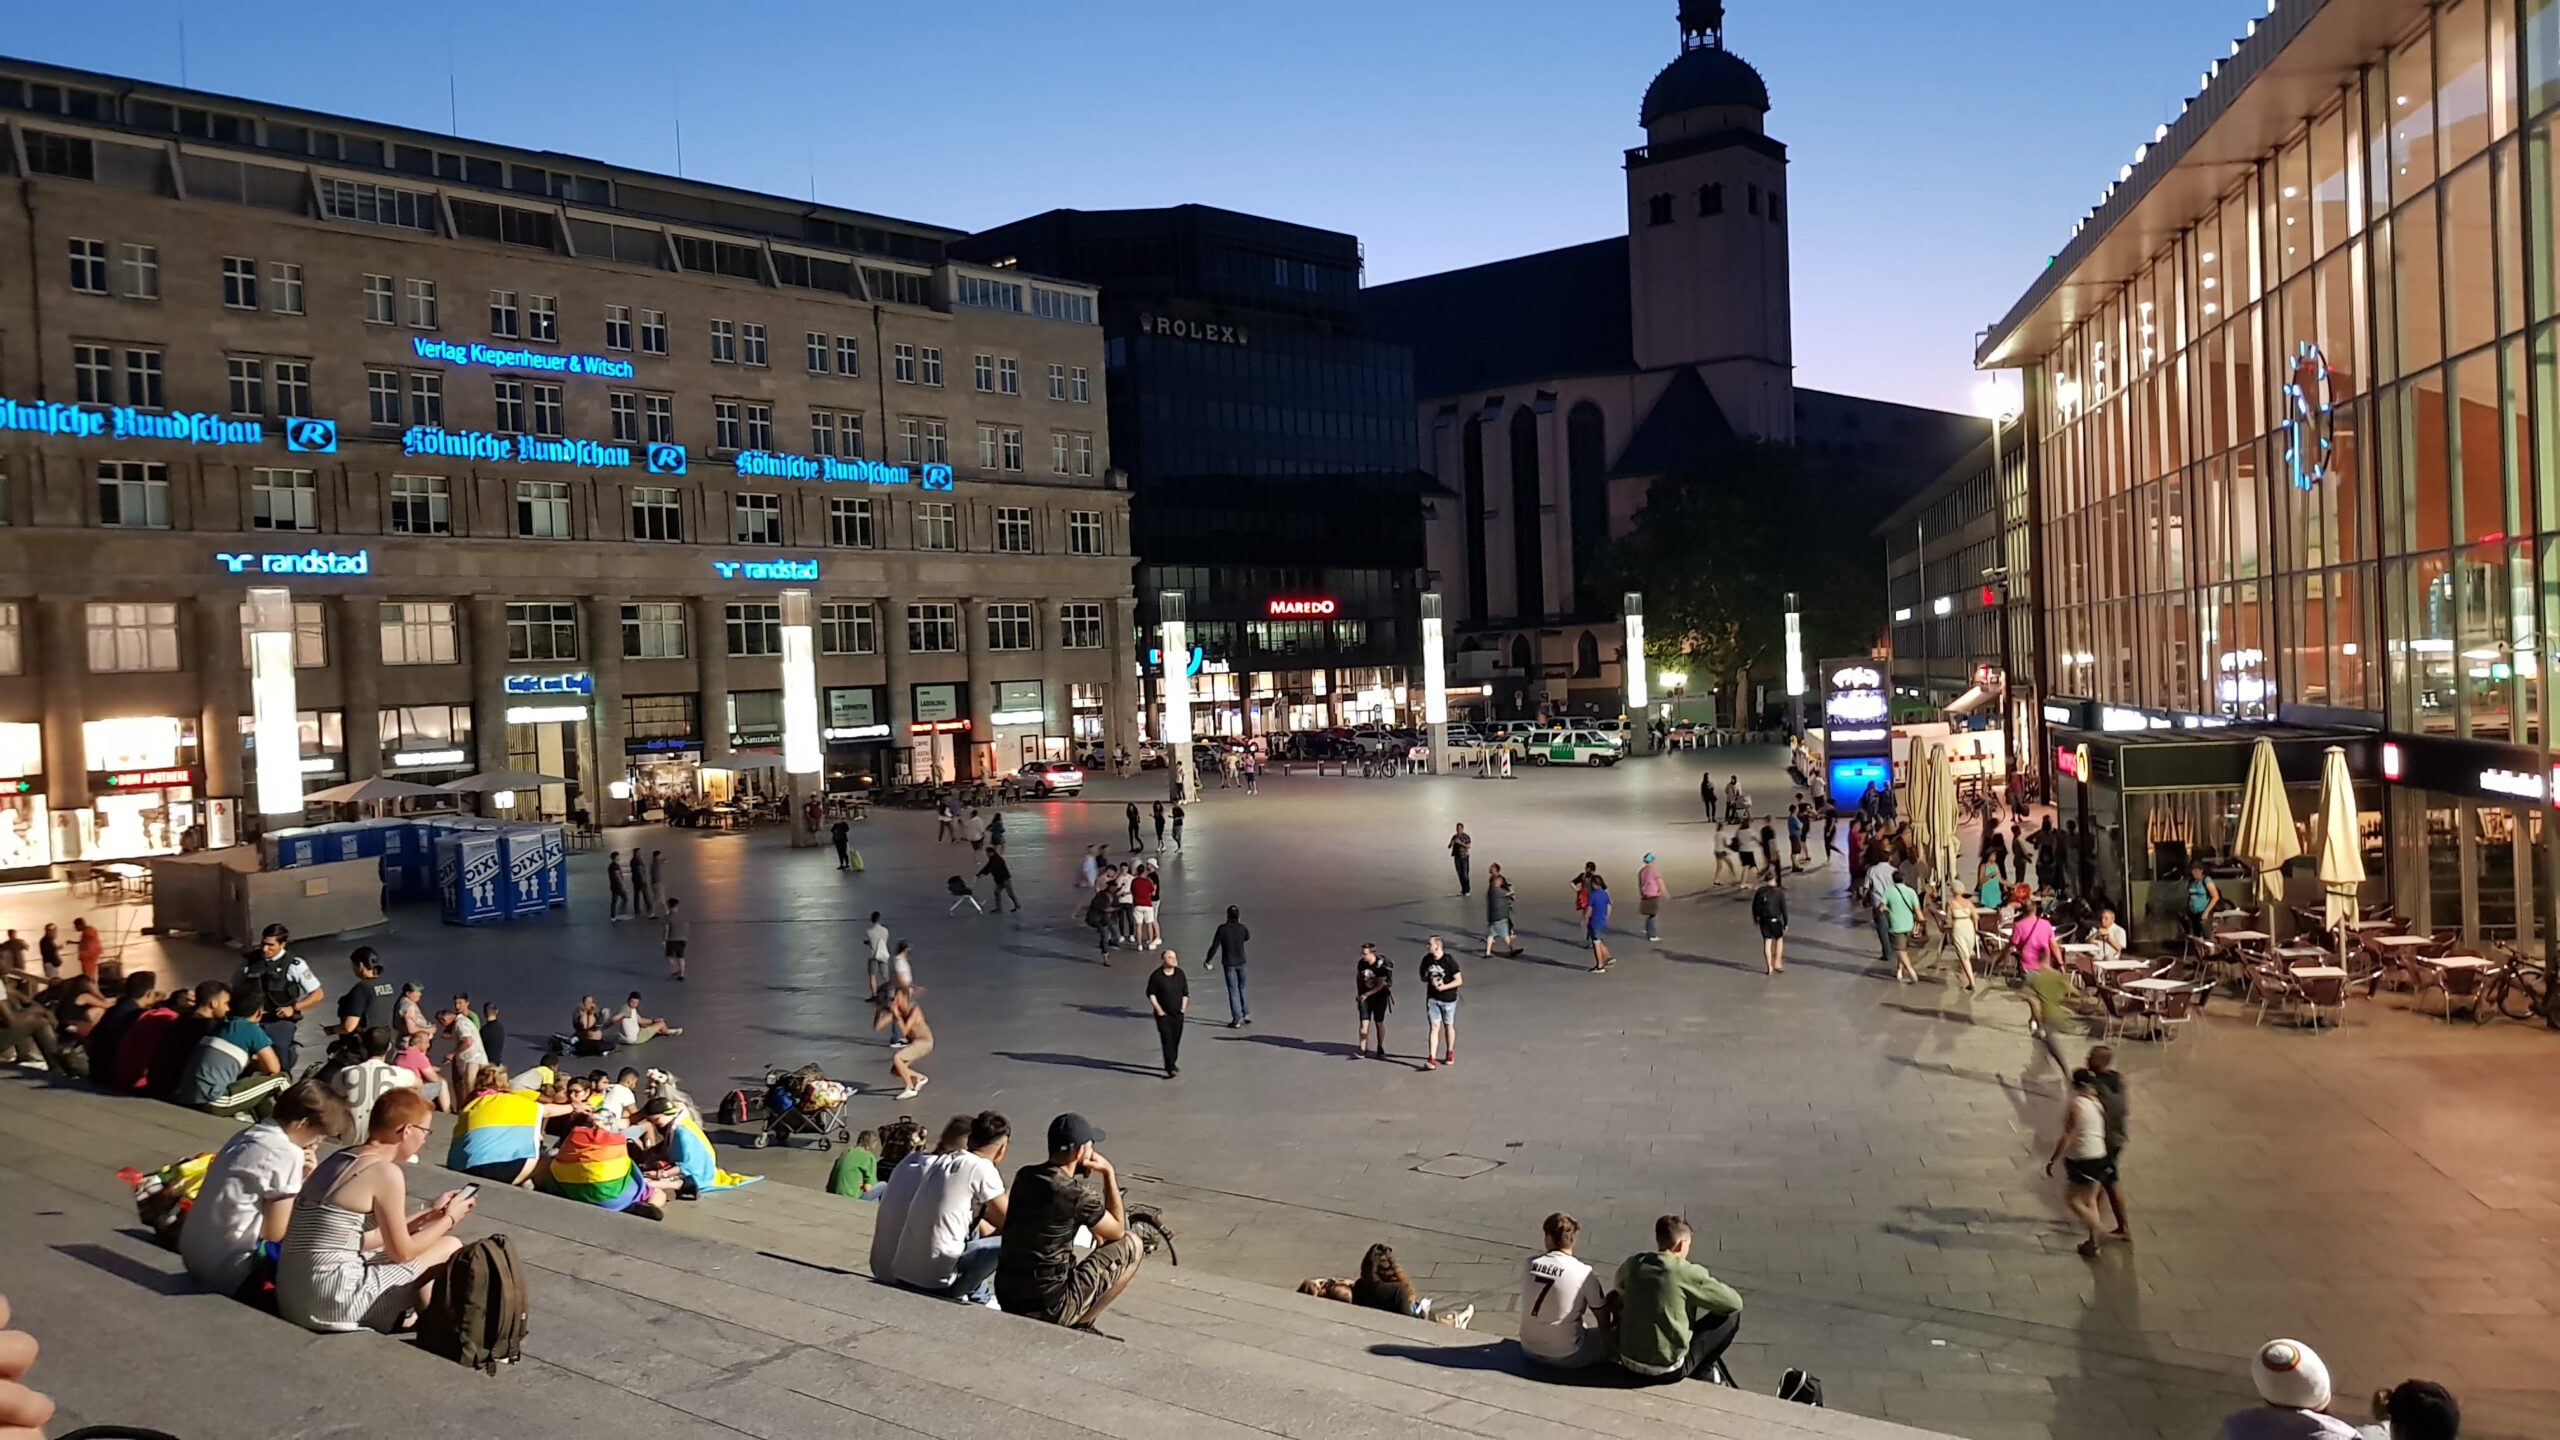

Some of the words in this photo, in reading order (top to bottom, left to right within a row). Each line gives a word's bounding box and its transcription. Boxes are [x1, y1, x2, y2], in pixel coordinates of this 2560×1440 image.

[1157, 316, 1235, 344] ROLEX
[413, 337, 467, 365] Verlag
[470, 343, 568, 371] Kiepenheuer
[569, 356, 581, 371] &
[583, 355, 634, 378] Witsch
[261, 548, 369, 574] randstad
[744, 558, 819, 581] randstad
[1270, 600, 1335, 614] MAREDO
[1201, 658, 1229, 674] Bank
[743, 730, 782, 744] Santander
[342, 1065, 397, 1108] 96
[1531, 1275, 1555, 1317] 7
